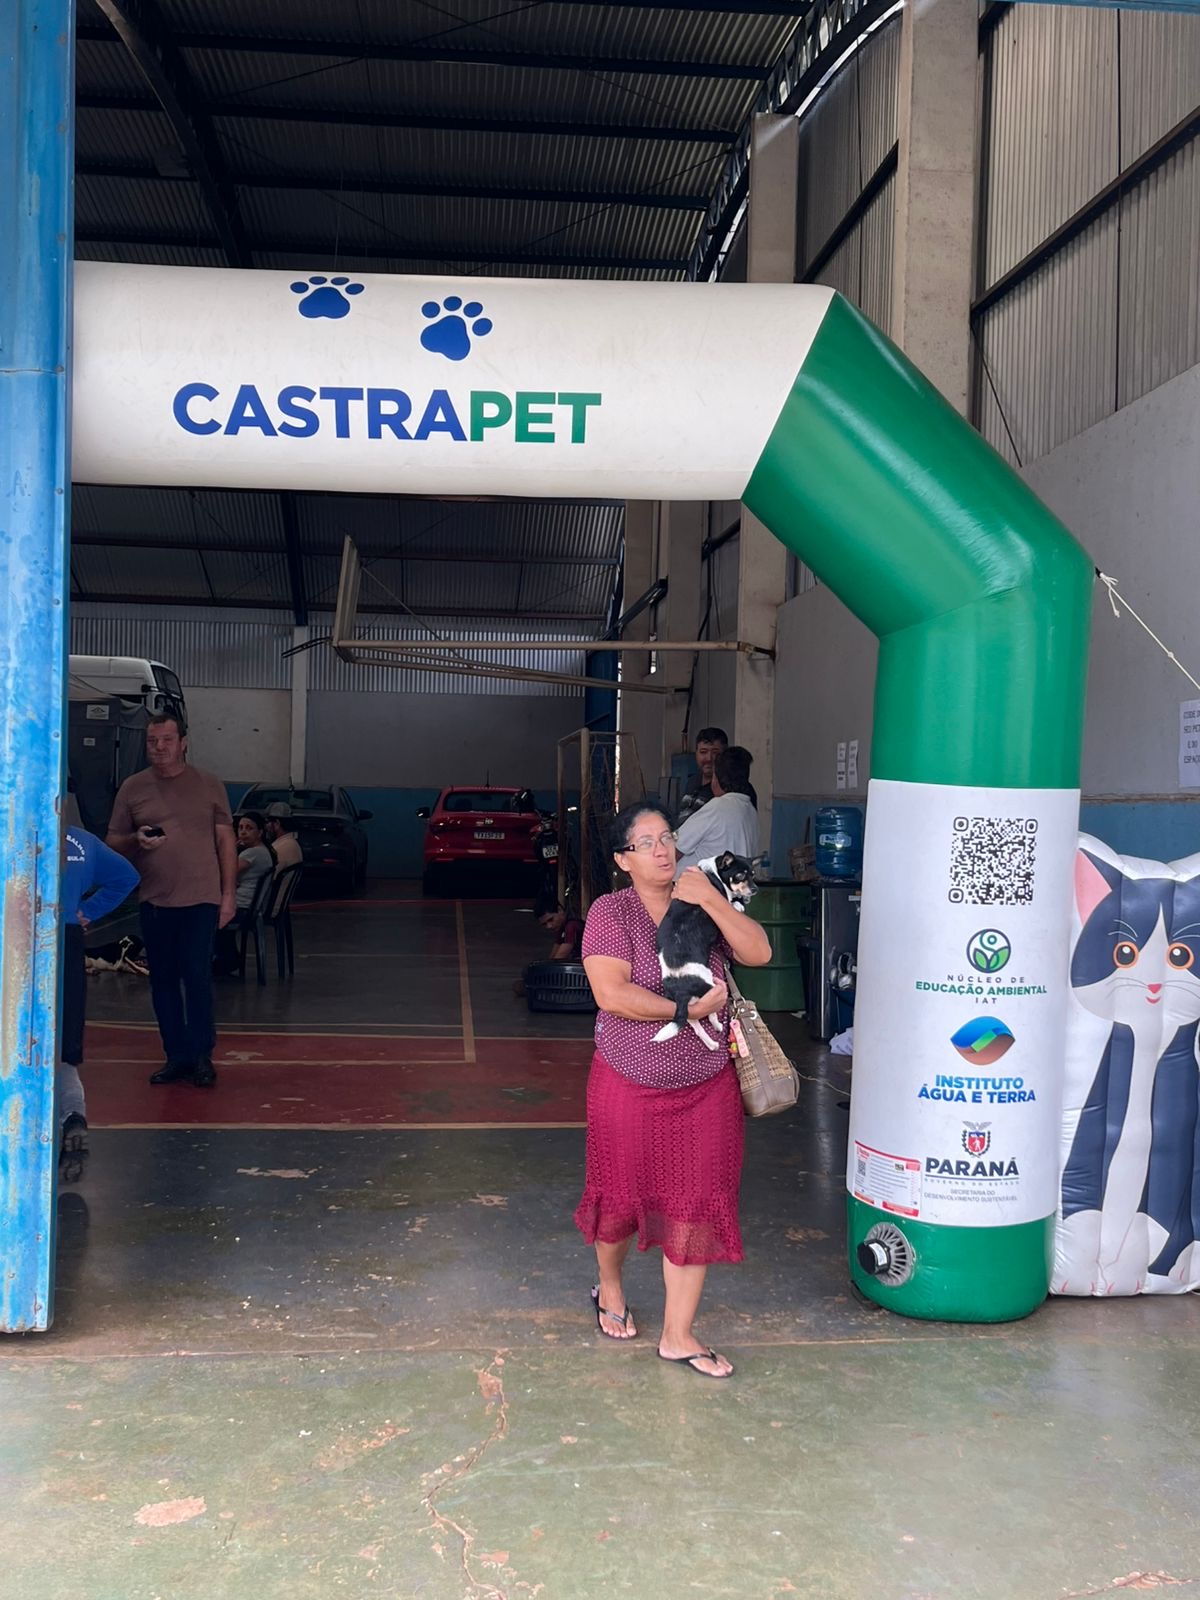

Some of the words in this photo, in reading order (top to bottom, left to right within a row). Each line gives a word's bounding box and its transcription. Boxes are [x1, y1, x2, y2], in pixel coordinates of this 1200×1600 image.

[172, 382, 602, 444] CASTRAPET
[947, 974, 1002, 983] NÚCLEO
[915, 981, 984, 996] EDUCAÇÃO
[986, 985, 1047, 996] AMBIENTAL
[935, 1074, 1024, 1090] INSTITUTO
[918, 1084, 967, 1103] ÁGUA
[971, 1091, 983, 1103] E
[986, 1089, 1036, 1104] TERRA
[925, 1156, 1020, 1177] PARANÁ
